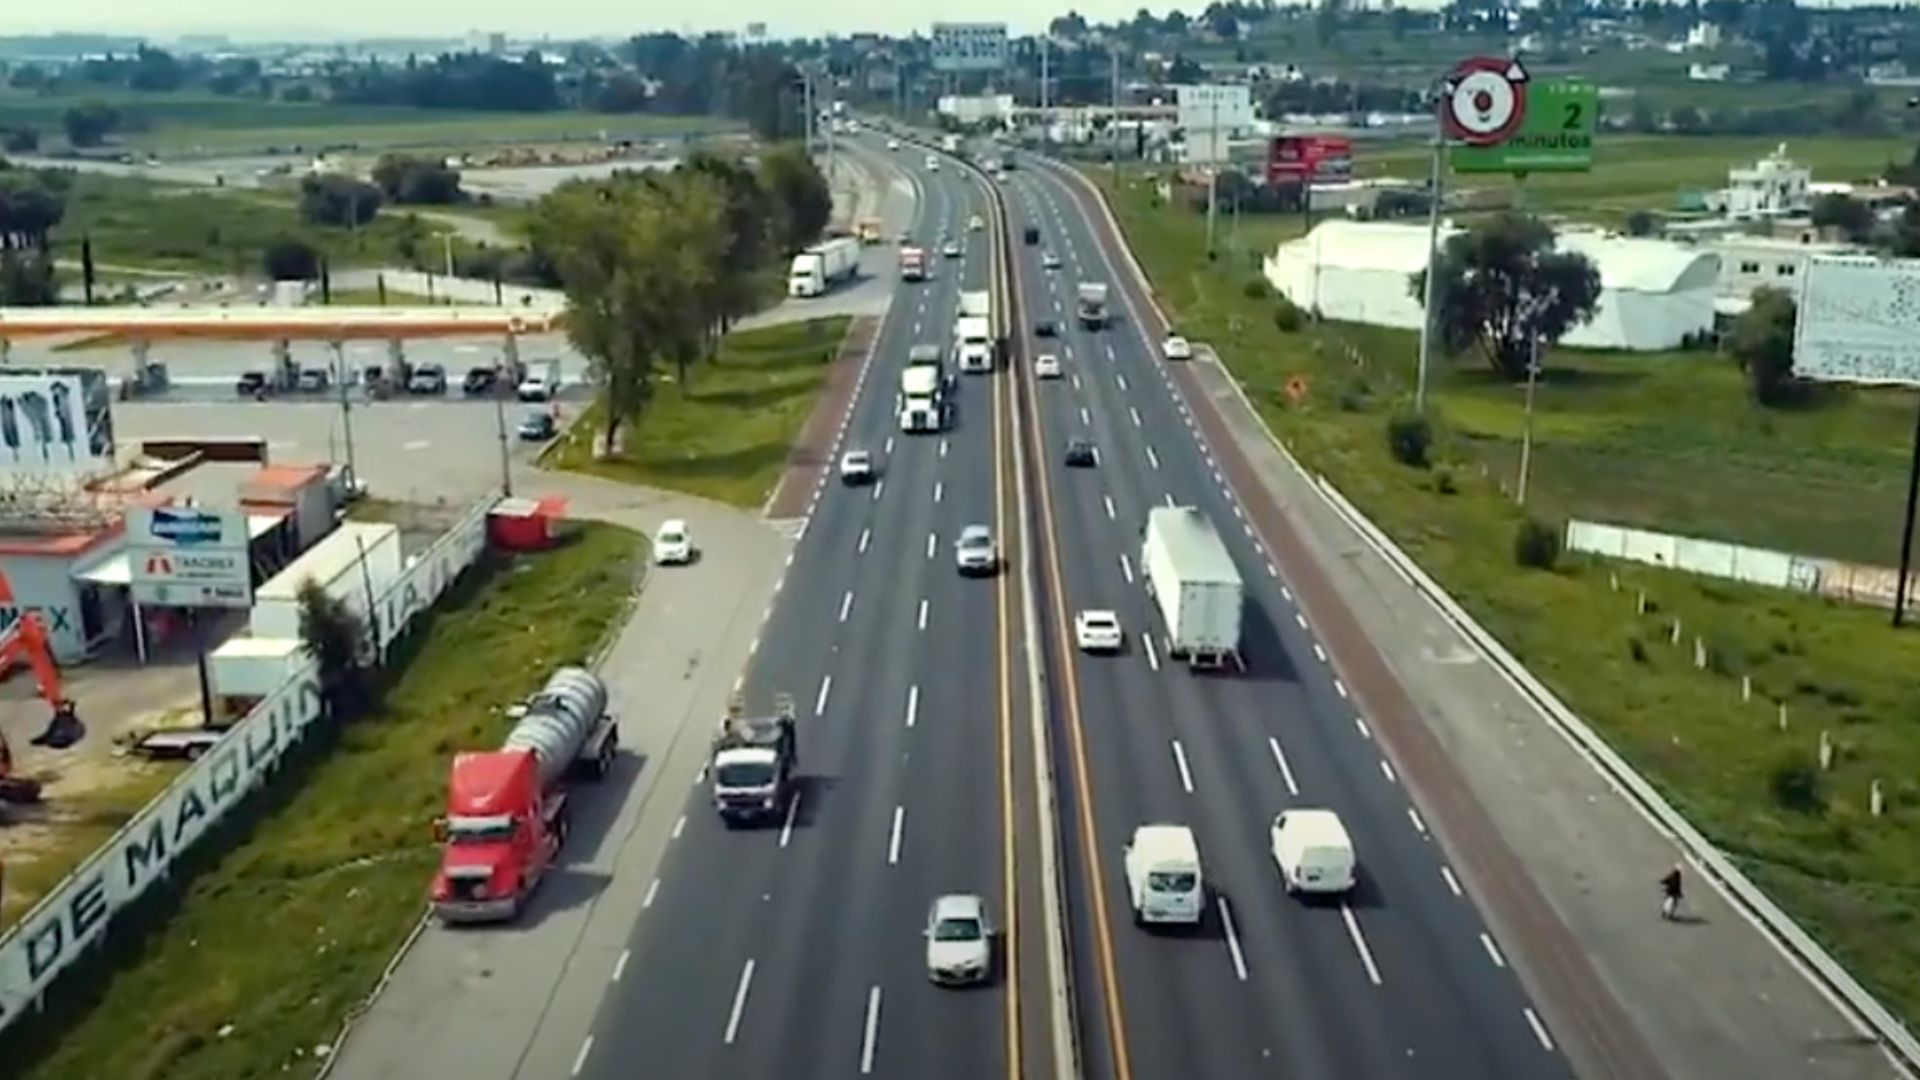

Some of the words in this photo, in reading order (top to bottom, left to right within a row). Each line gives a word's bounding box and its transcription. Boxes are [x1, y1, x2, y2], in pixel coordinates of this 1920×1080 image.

[1562, 103, 1582, 129] 2
[1510, 132, 1591, 149] minutos
[27, 873, 107, 981] DE
